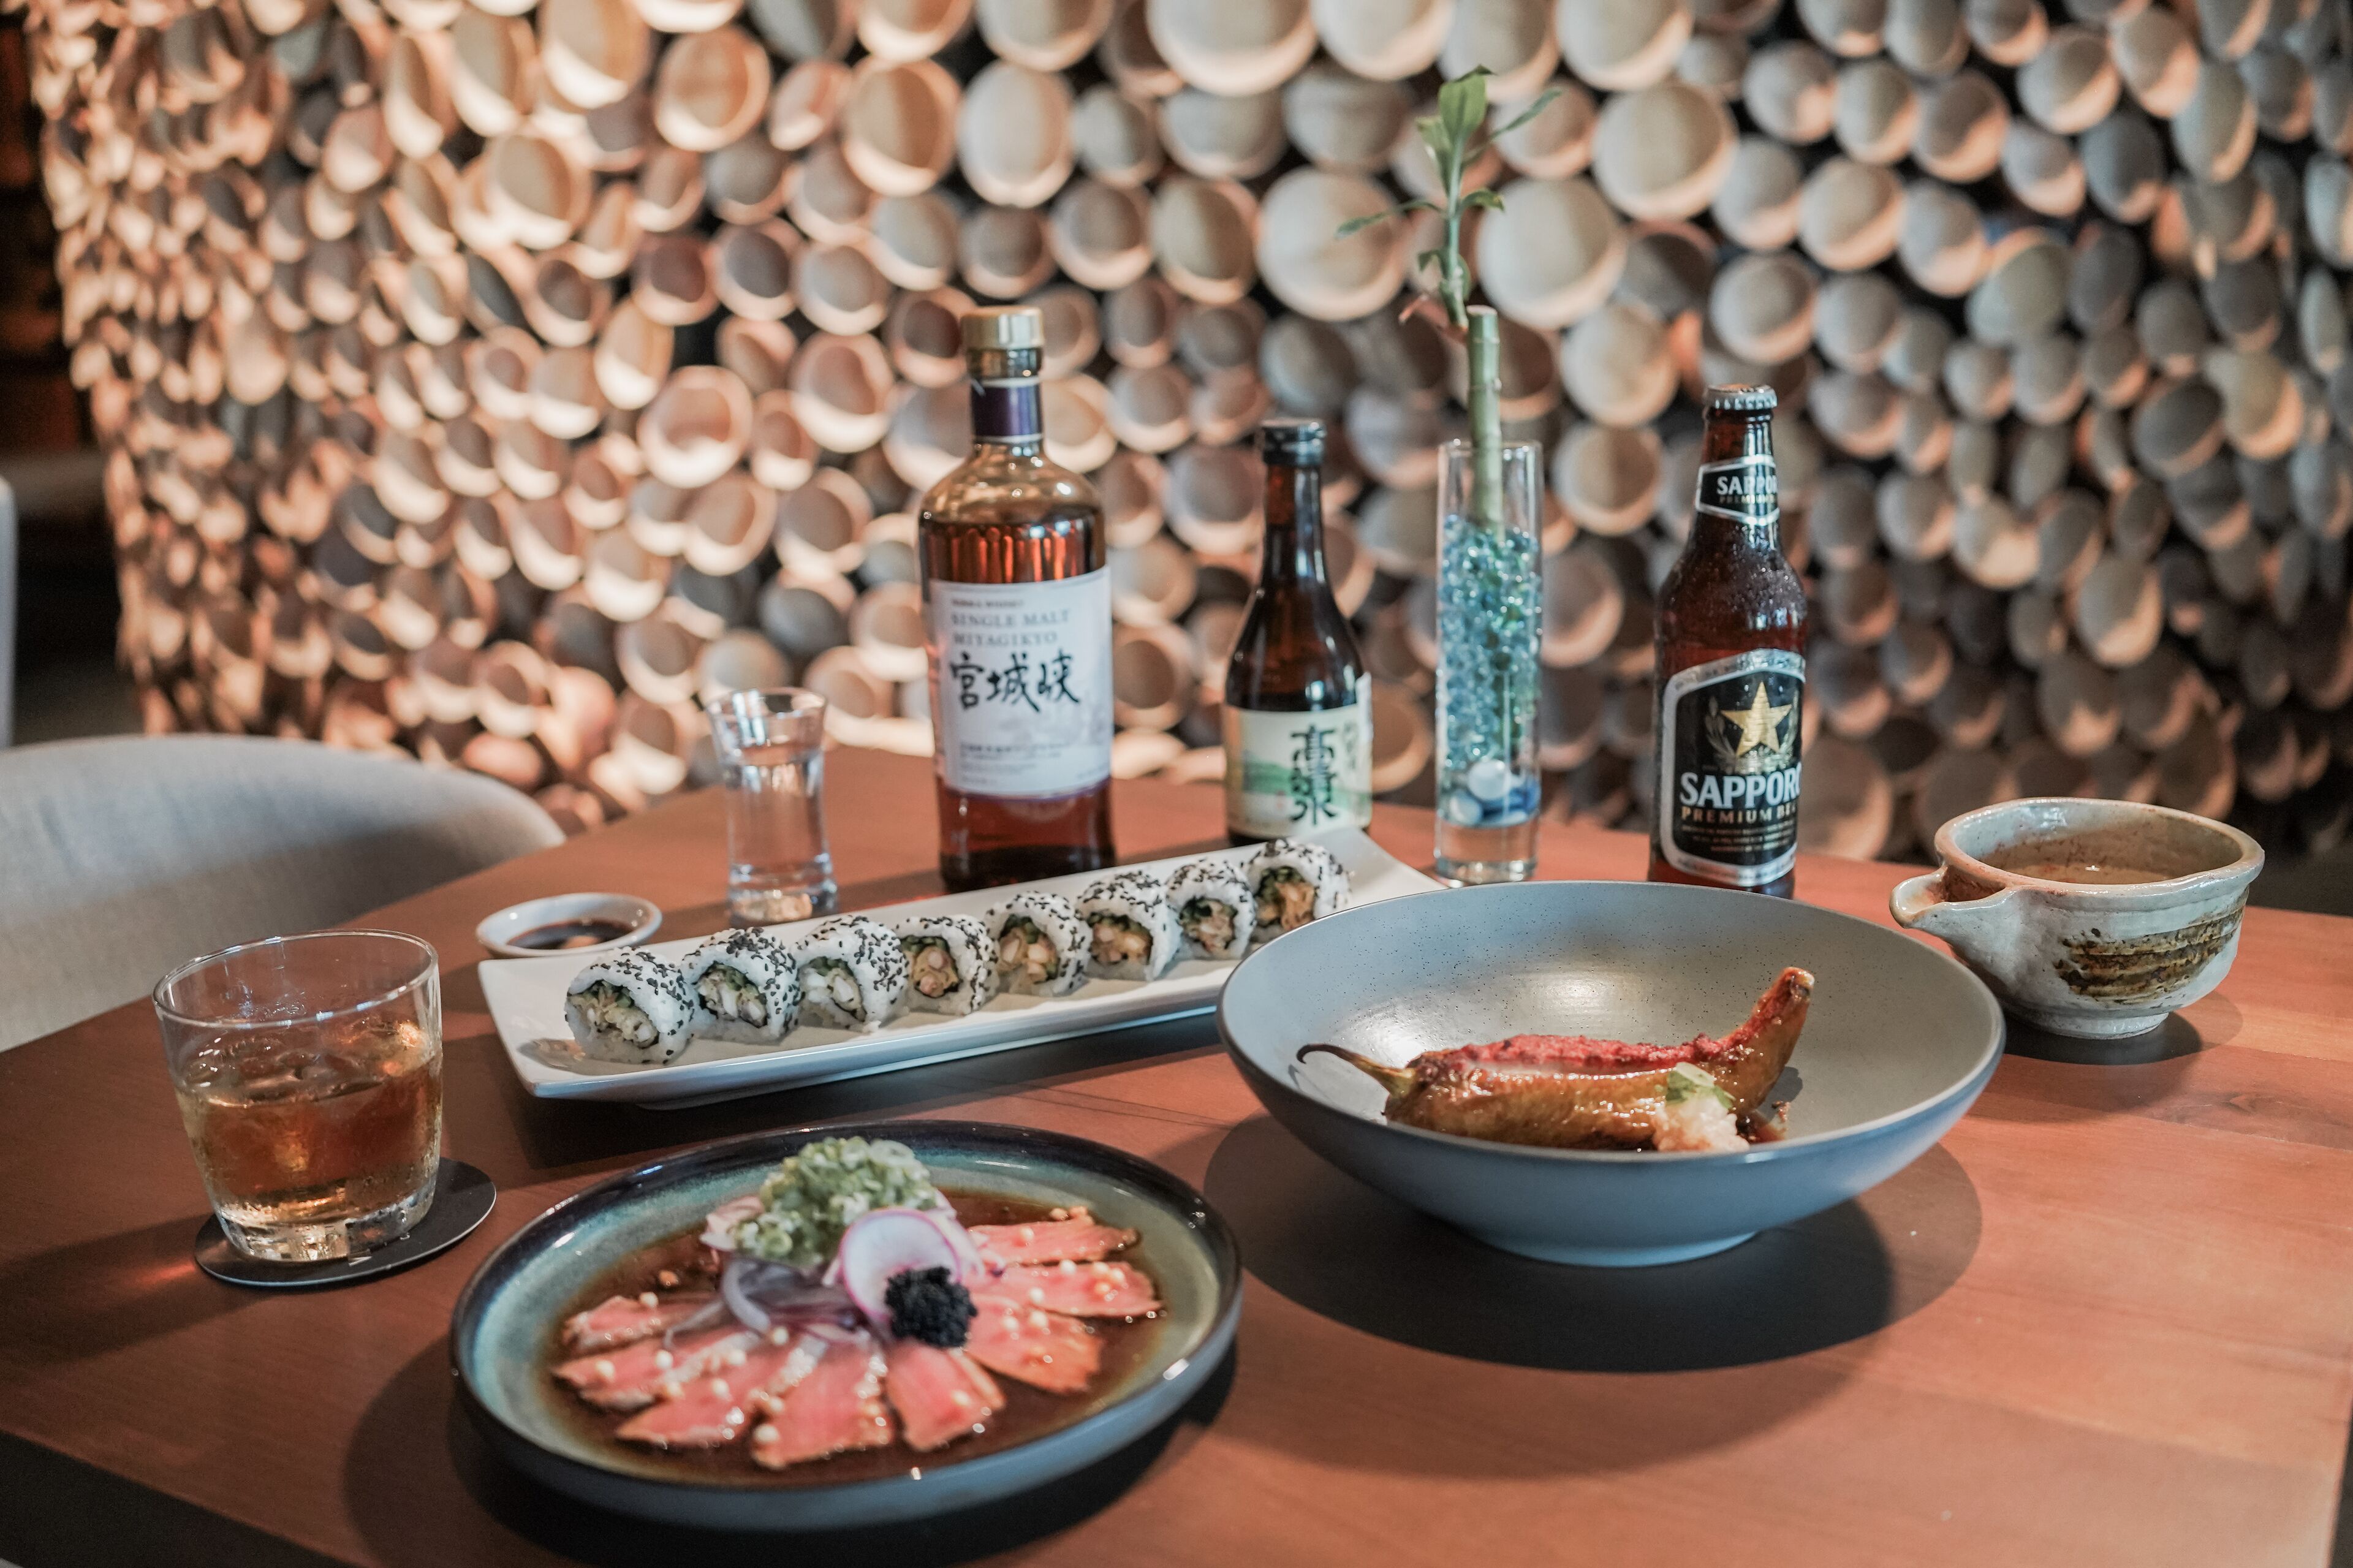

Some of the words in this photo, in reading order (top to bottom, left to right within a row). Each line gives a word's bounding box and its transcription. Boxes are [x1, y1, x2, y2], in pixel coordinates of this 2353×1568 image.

[951, 613, 1015, 627] SINGLE
[1025, 610, 1070, 624] MALT
[953, 632, 1058, 646] MIYAGIKYO
[950, 649, 1080, 713] 宮城峡
[1681, 806, 1772, 824] PREMIUM
